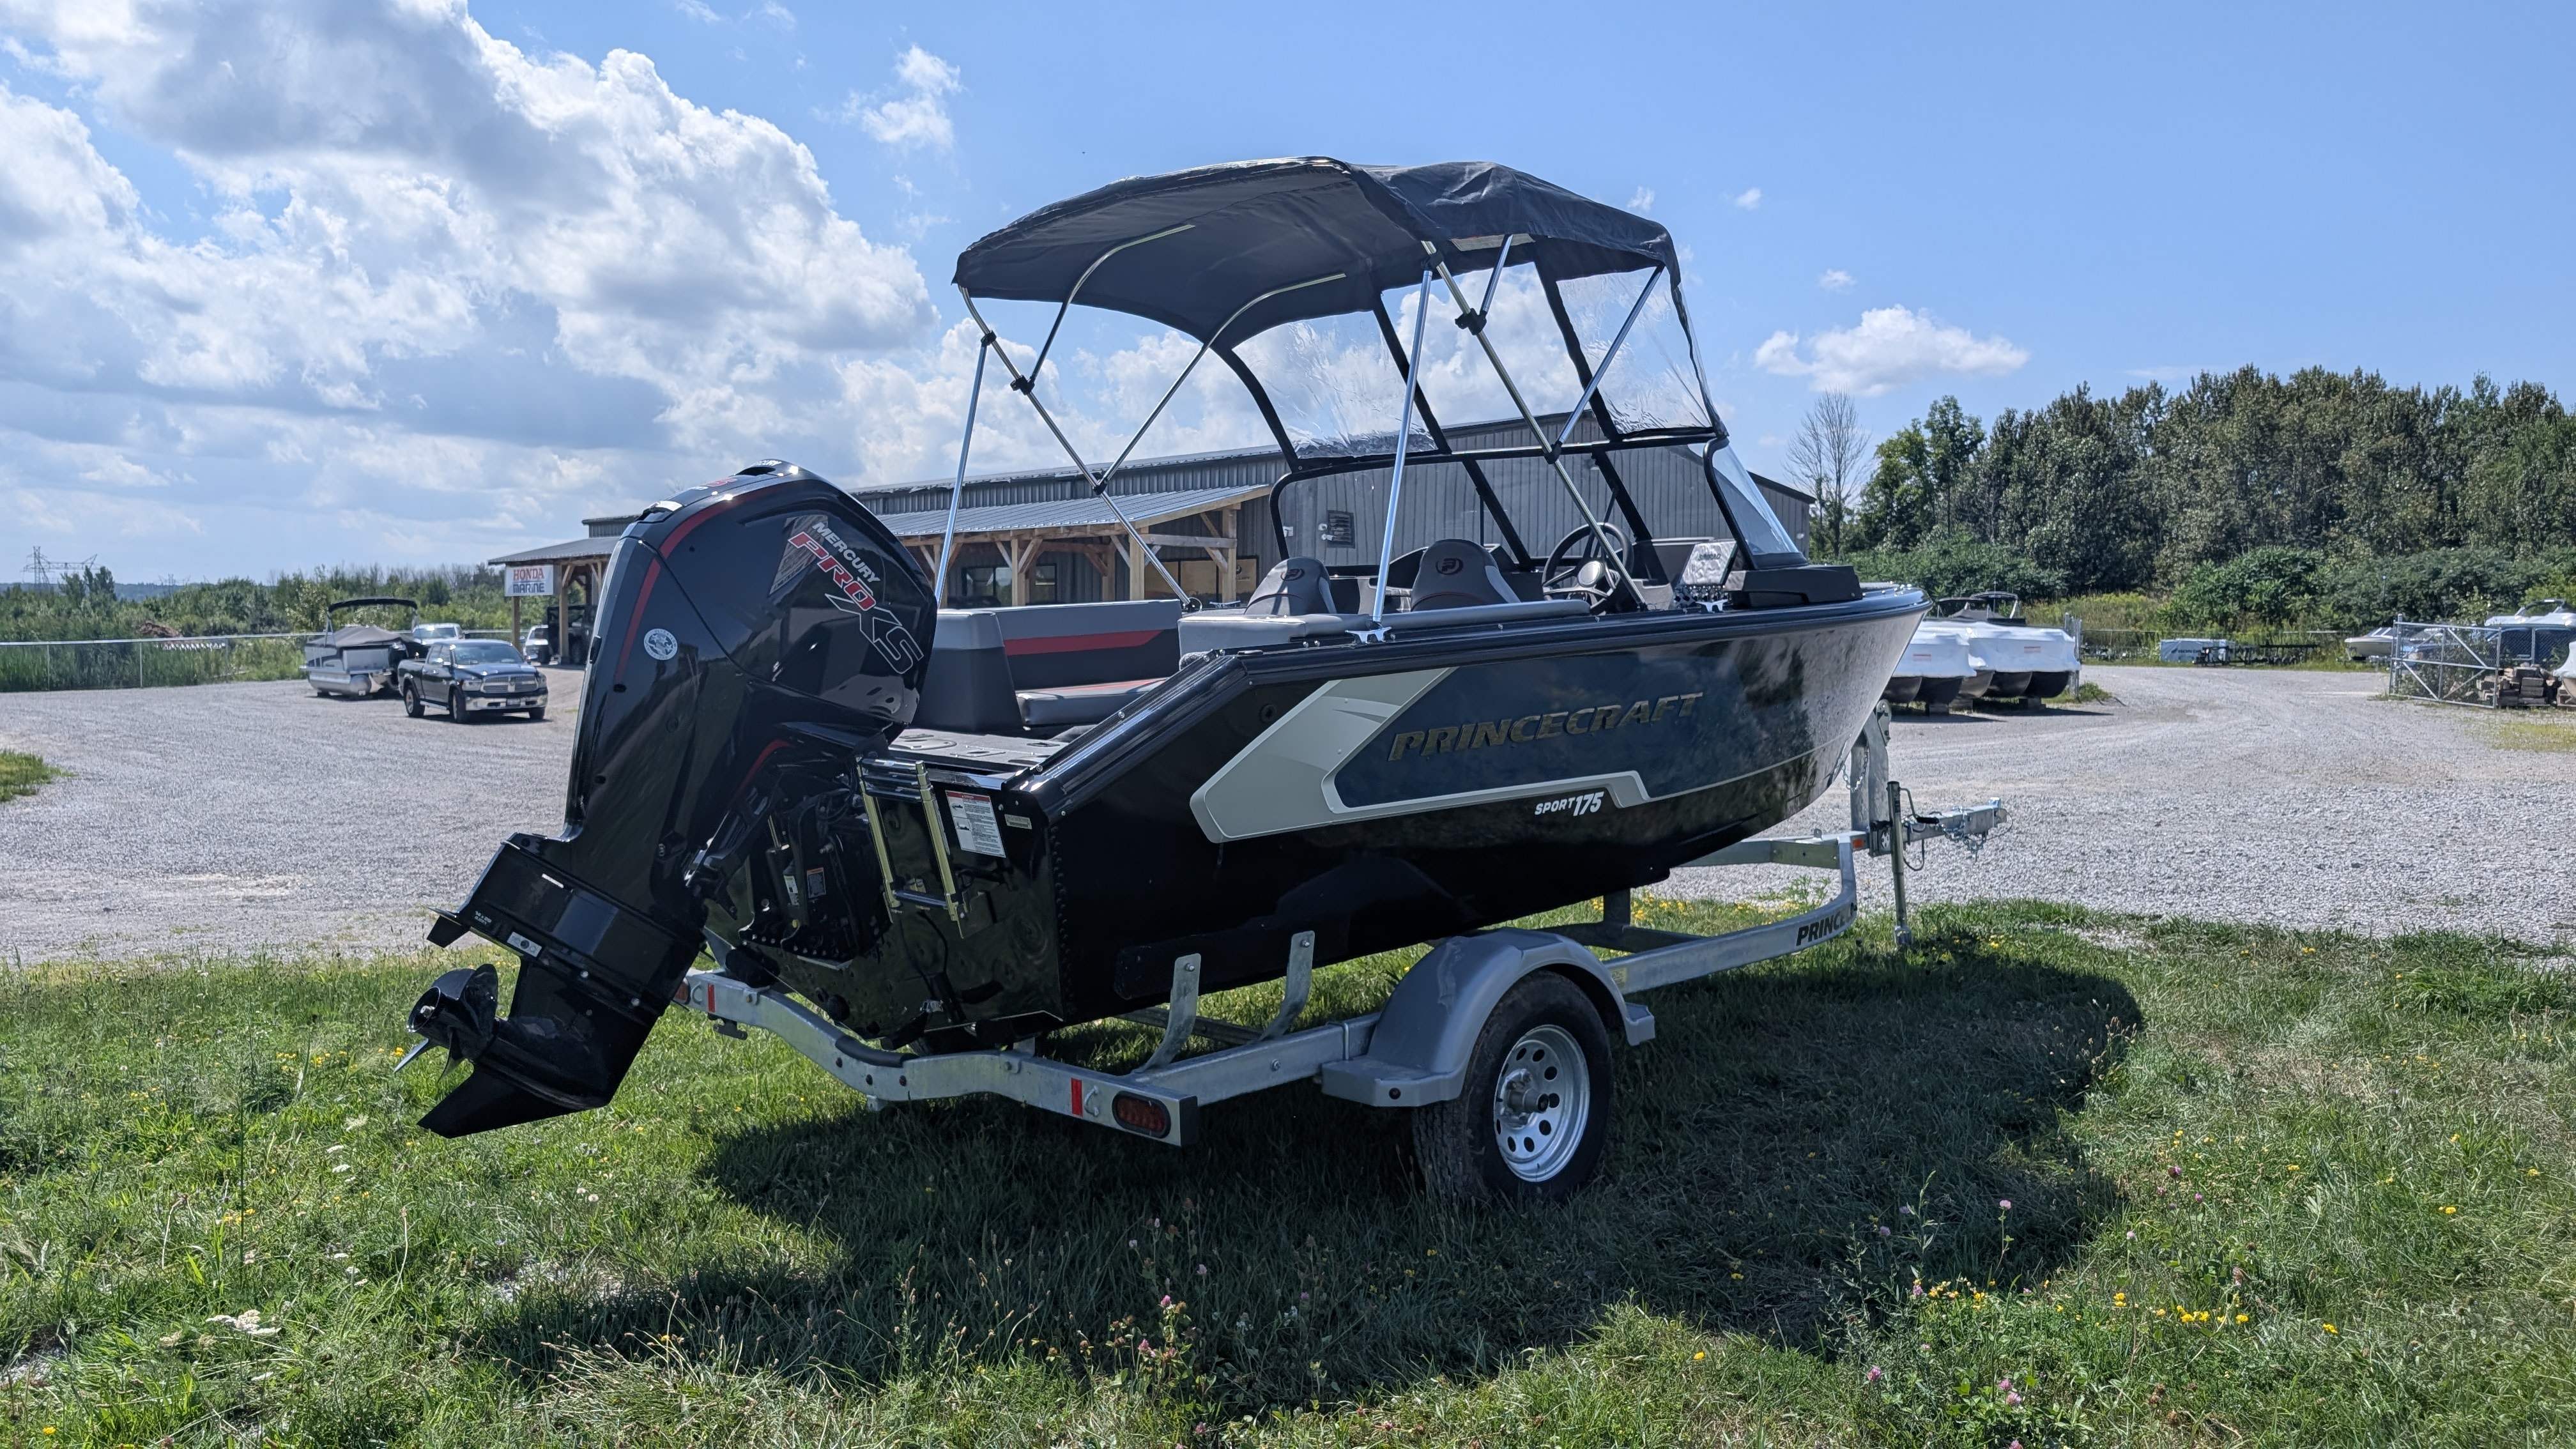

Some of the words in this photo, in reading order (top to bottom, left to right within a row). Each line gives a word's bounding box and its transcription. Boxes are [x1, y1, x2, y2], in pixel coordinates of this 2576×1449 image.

[513, 568, 544, 581] HONDA
[788, 531, 877, 611] PRO
[812, 521, 880, 583] MERCURY
[824, 577, 924, 674] XS
[1387, 691, 1703, 762] PRINCECRAFT
[1534, 797, 1575, 815] SPORT
[1573, 791, 1604, 816] 175
